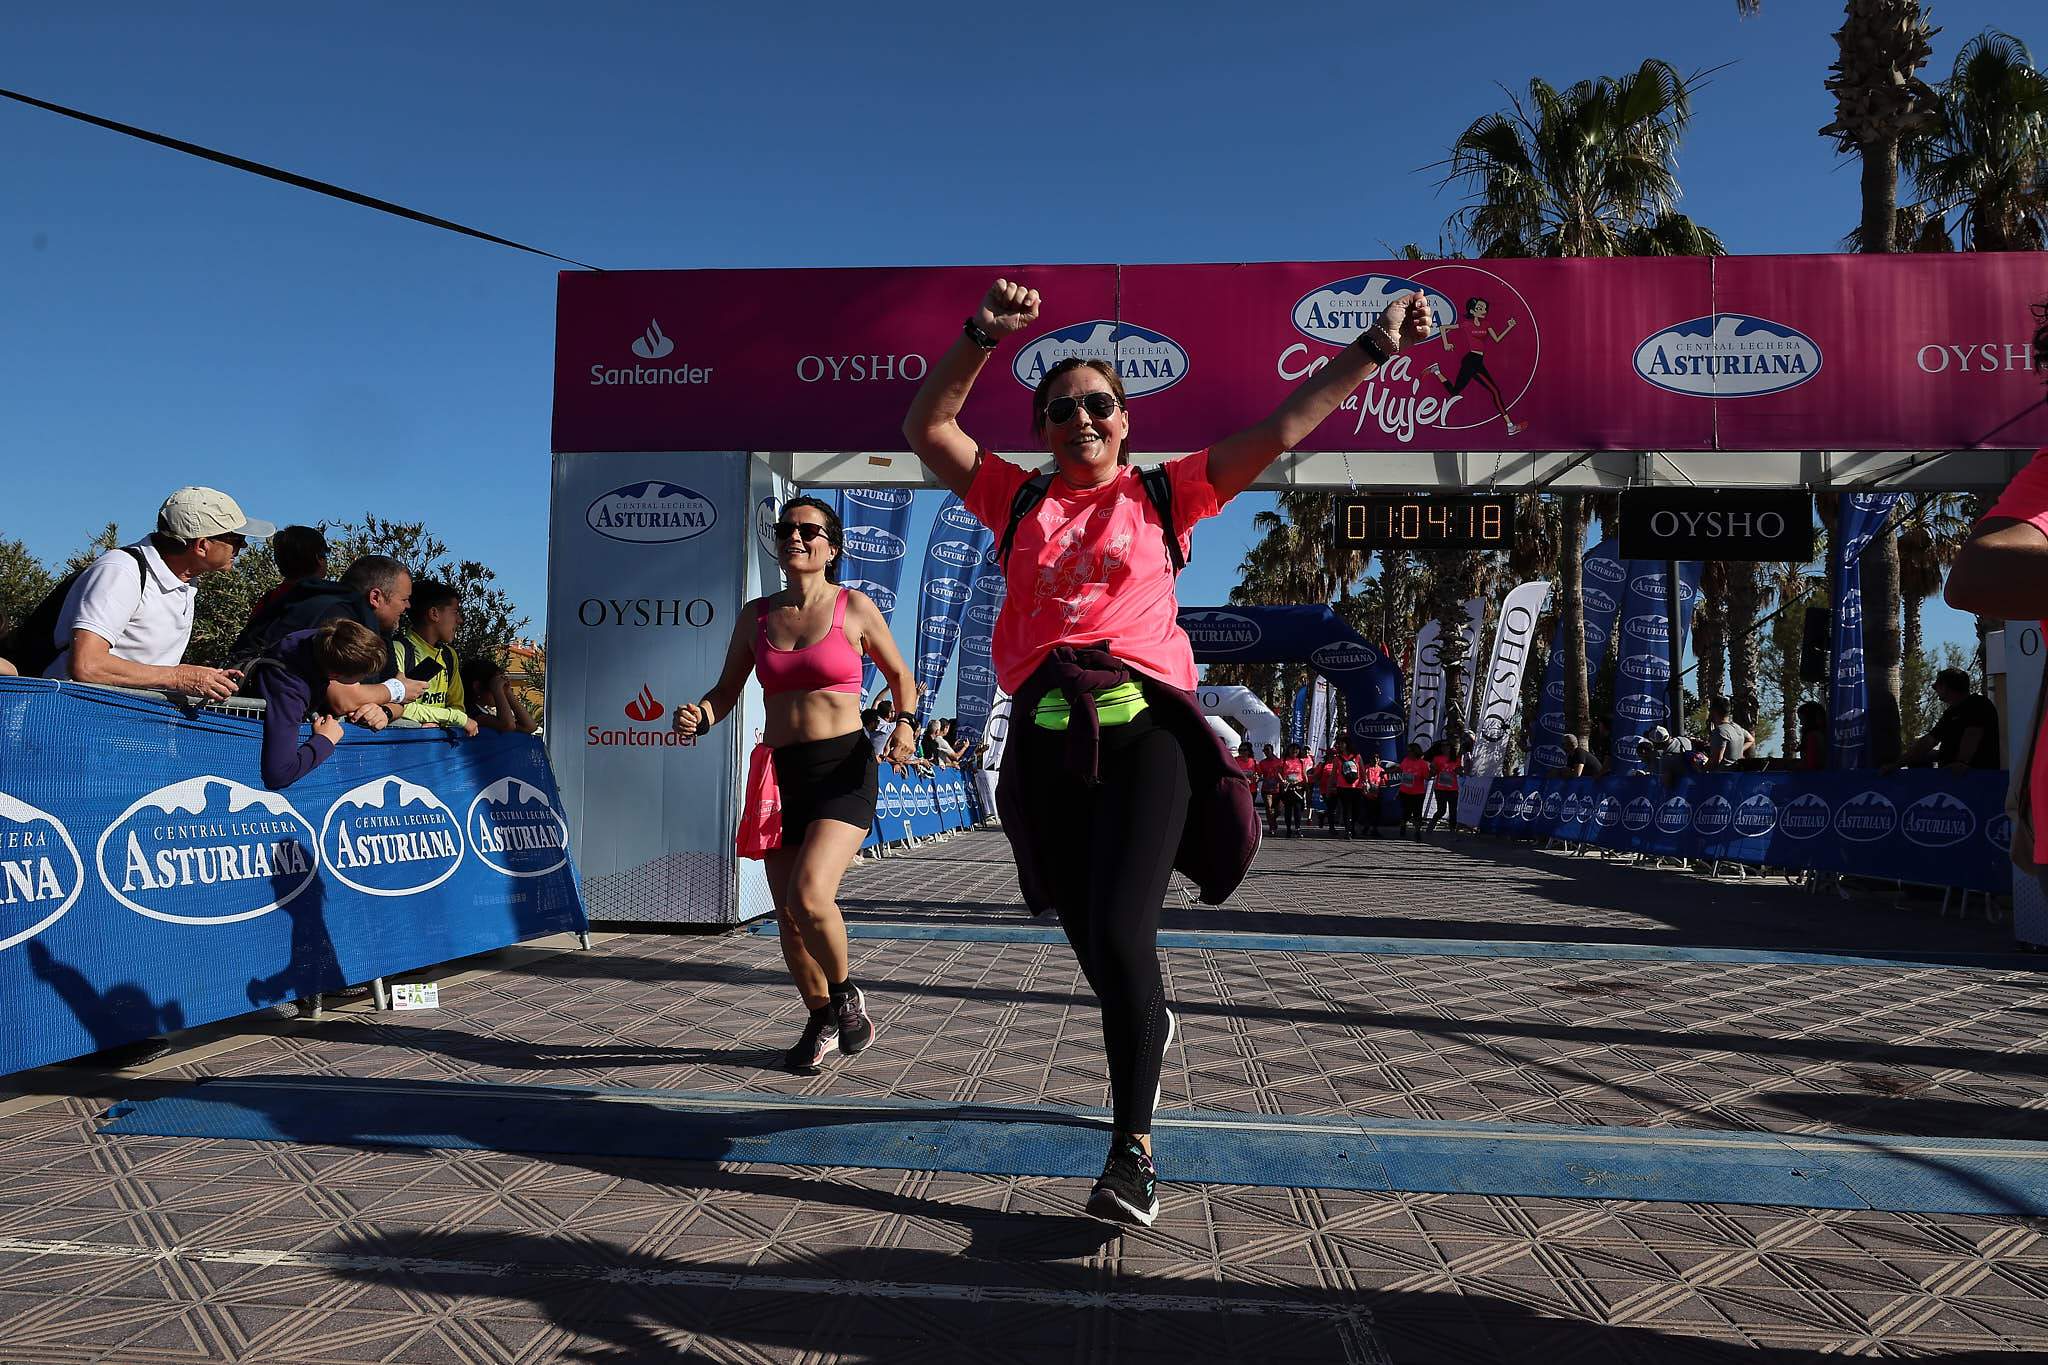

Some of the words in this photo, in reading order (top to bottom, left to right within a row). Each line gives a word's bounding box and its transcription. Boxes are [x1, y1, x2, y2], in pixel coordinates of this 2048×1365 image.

[1304, 301, 1443, 328] ASTUA
[1053, 348, 1108, 356] CENTRAL
[1648, 344, 1808, 375] ASTURIANA
[1676, 343, 1734, 351] CENTRAL
[1740, 341, 1801, 350] LECHERA
[1917, 343, 2033, 373] OYSH
[590, 363, 713, 385] Santander
[796, 353, 927, 382] OYSHO
[1025, 350, 1175, 380] AIANA
[1353, 378, 1463, 442] Mujer
[595, 503, 708, 528] ASTURIANA
[1650, 510, 1785, 538] OYSHO
[578, 598, 714, 628] OYSHO
[1189, 630, 1254, 642] TURIANA
[1629, 621, 1669, 637] ASTURIA
[1316, 654, 1374, 664] ASTURIANA
[1482, 606, 1531, 742] OYSHO
[154, 823, 227, 840] CENTRAL
[232, 821, 298, 836] LECHERA
[355, 815, 401, 829] CENTRAL
[405, 813, 447, 826] LECHERA
[1837, 808, 1890, 830] ASTURIANA
[1905, 810, 1967, 834] ASTURIANA
[337, 819, 458, 869] ASTURIANA
[479, 813, 562, 853] ASTURIAN
[122, 830, 308, 892] ASTURIANA
